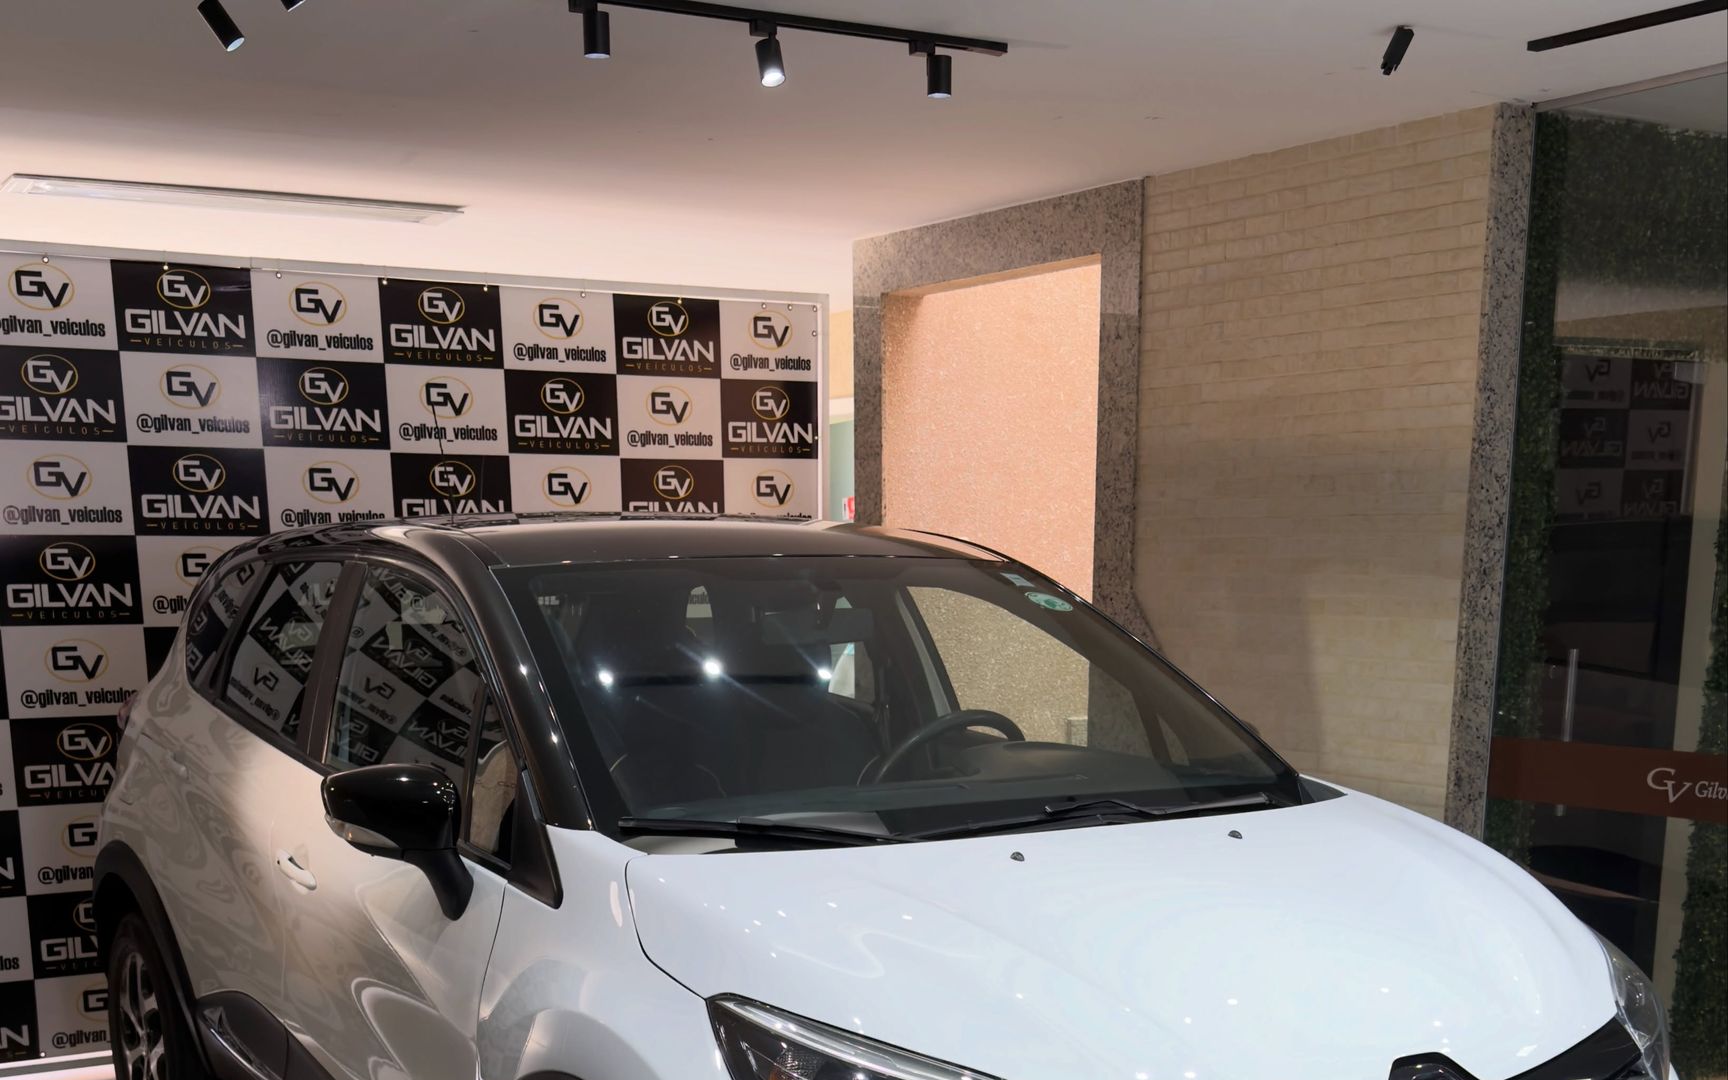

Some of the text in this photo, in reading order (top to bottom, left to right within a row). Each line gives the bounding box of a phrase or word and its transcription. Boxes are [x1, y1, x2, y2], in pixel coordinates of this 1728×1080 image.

[15, 270, 69, 308] GV
[163, 275, 206, 307] GV
[295, 288, 342, 323] GV
[423, 291, 461, 322] GV
[0, 315, 106, 337] gilvan_veiculos
[124, 308, 246, 338] GILVAN
[538, 304, 580, 337] GV
[651, 306, 685, 335] GV
[753, 316, 789, 348] GV
[267, 329, 374, 351] @gilvan_veiculos
[390, 323, 495, 352] GILVAN
[622, 337, 715, 362] GILVAN
[513, 343, 607, 362] @gilvan_veiculos
[730, 354, 811, 371] @gilvan_veiculos
[27, 360, 73, 392] GV
[166, 371, 216, 407] GV
[304, 372, 345, 402] GV
[0, 396, 116, 424] GILVAN
[425, 383, 469, 416] GV
[545, 383, 582, 412] GV
[651, 392, 689, 423] GV
[756, 391, 787, 418] GV
[136, 414, 250, 434] @gilvan_veiculos
[269, 405, 382, 433] GILVAN
[399, 422, 498, 443] @gilvan_veiculos
[514, 415, 612, 440] GILVAN
[728, 421, 813, 445] GILVAN
[627, 430, 713, 448] @gilvan_veiculos
[33, 461, 87, 497] GV
[178, 459, 221, 489] GV
[309, 467, 355, 501] GV
[434, 466, 472, 494] GV
[548, 473, 588, 504] GV
[658, 470, 691, 498] GV
[757, 476, 791, 505] GV
[3, 505, 122, 526] @gilvan_veiculos
[141, 494, 261, 520] GILVAN
[44, 548, 91, 579] GV
[6, 583, 133, 609] GILVAN
[51, 646, 104, 680] GV
[62, 729, 107, 759] GV
[24, 761, 117, 789] GILVA
[1647, 767, 1728, 803] GV Gilv
